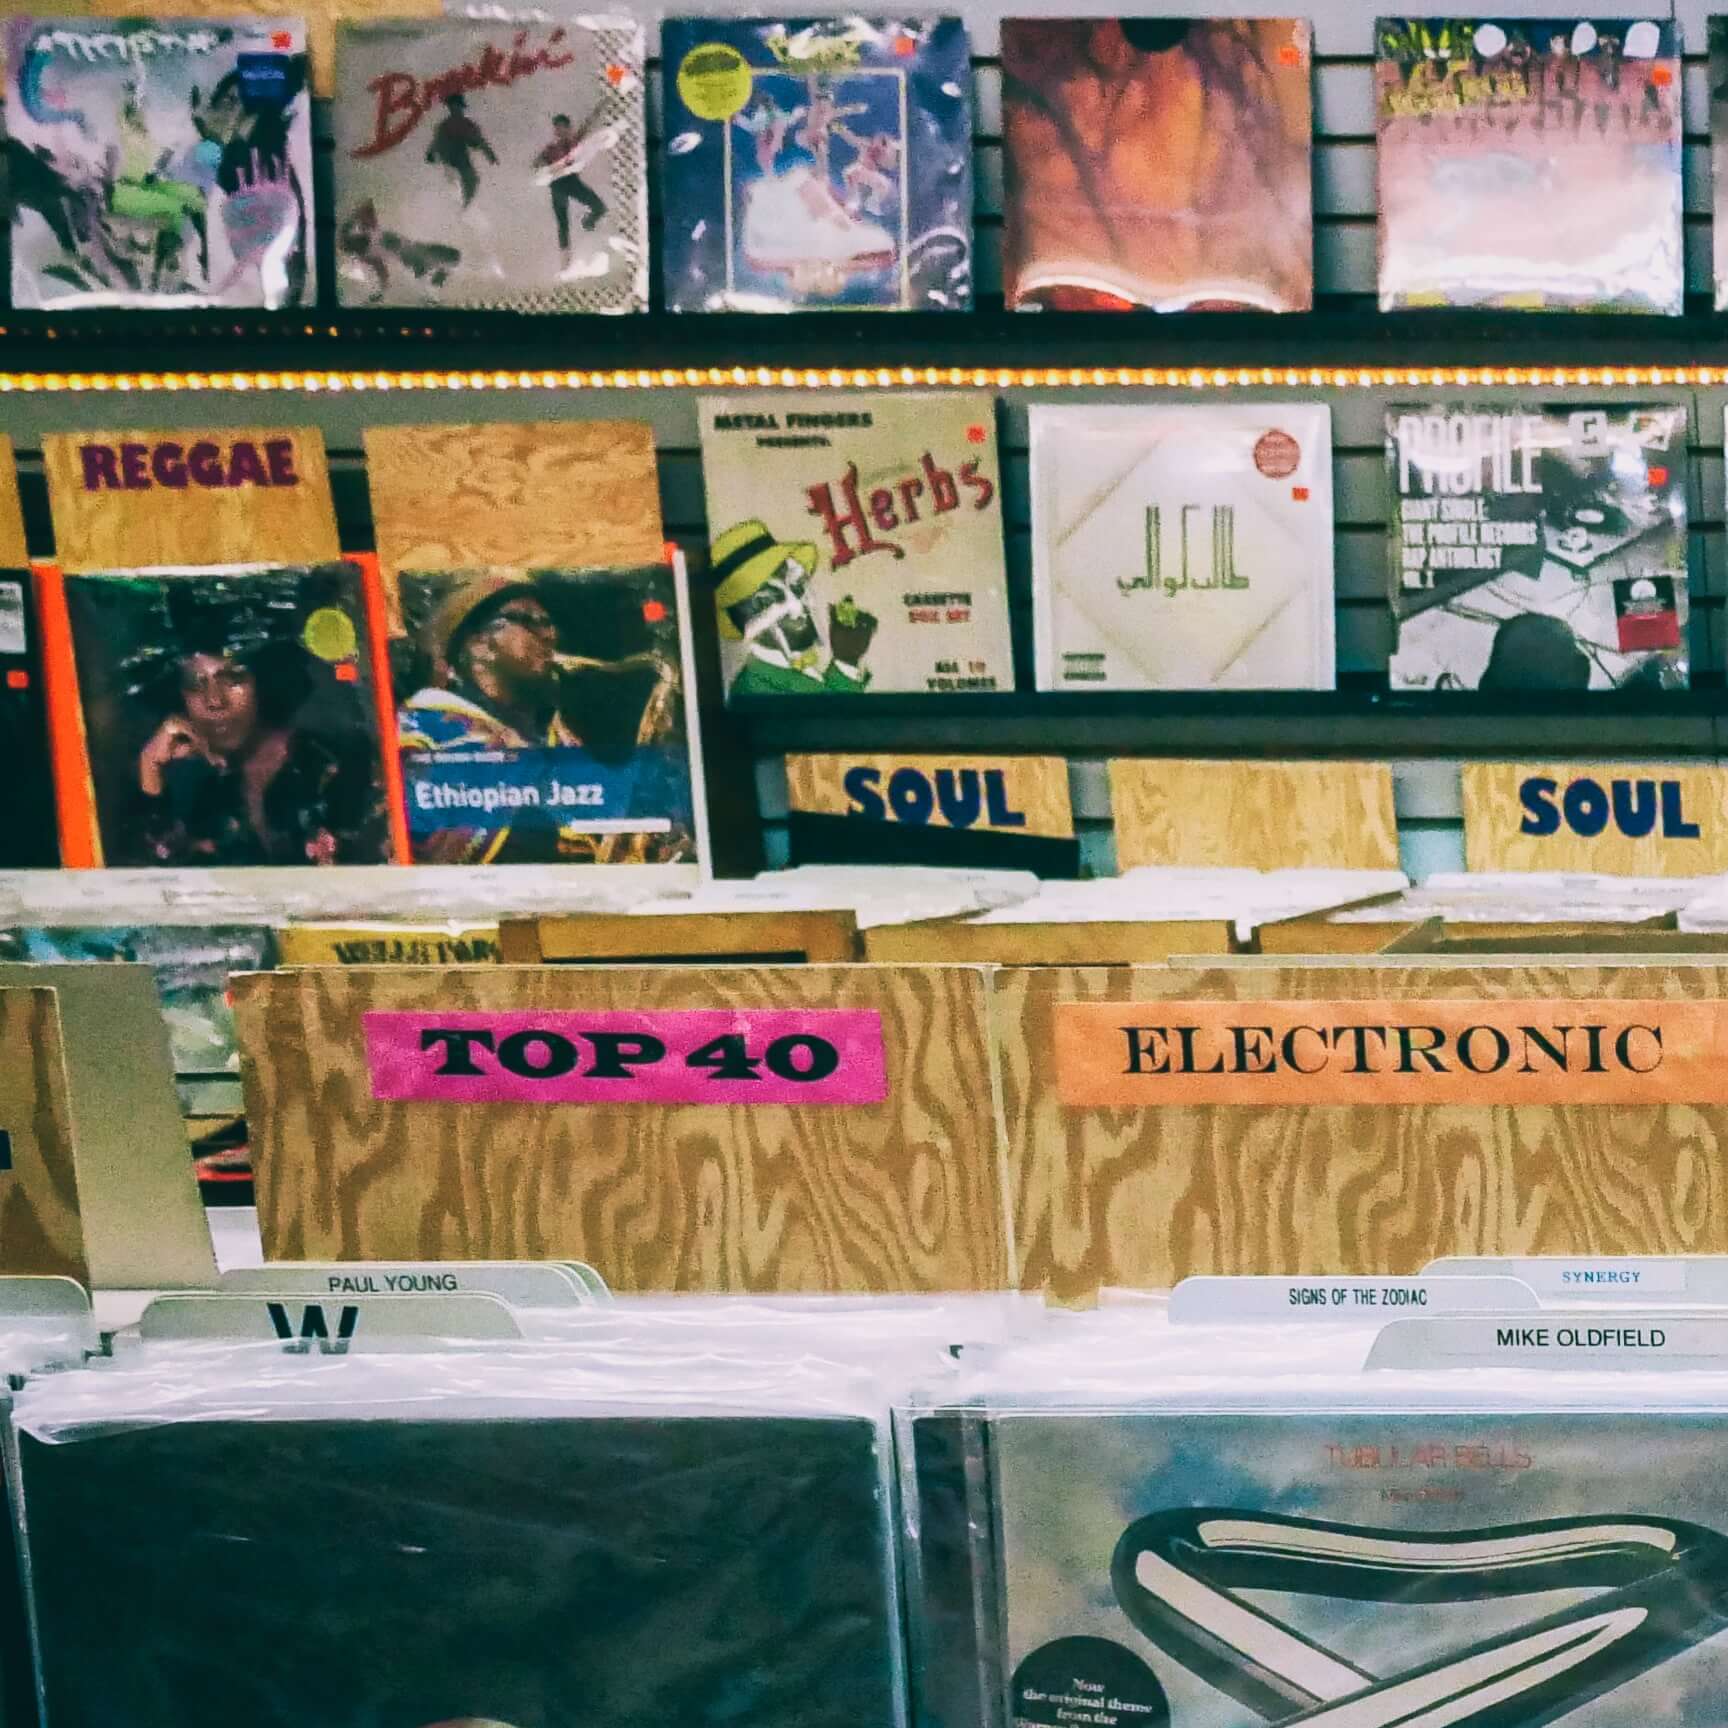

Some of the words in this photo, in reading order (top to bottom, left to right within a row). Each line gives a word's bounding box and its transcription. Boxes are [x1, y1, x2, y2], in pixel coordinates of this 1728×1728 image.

[81, 441, 295, 491] REGGAE
[807, 451, 993, 574] Herbs
[415, 782, 539, 813] Ethiopian
[547, 781, 603, 806] Jazz
[845, 767, 1025, 829] SOUL
[1519, 777, 1700, 838] SOUL
[420, 1030, 666, 1078] TOP
[684, 1033, 839, 1081] 40
[1119, 1025, 1665, 1076] ELECTRONIC
[328, 1276, 383, 1291] PAUL
[387, 1275, 458, 1292] YOUNG
[1288, 1287, 1326, 1306] SIGNS
[1330, 1287, 1349, 1306] OF
[1355, 1287, 1377, 1306] THE
[1381, 1287, 1428, 1306] ZODIAC
[1562, 1269, 1640, 1285] SYNERGY
[1497, 1328, 1550, 1347] MIKE
[1556, 1328, 1666, 1347] OLDFIELD
